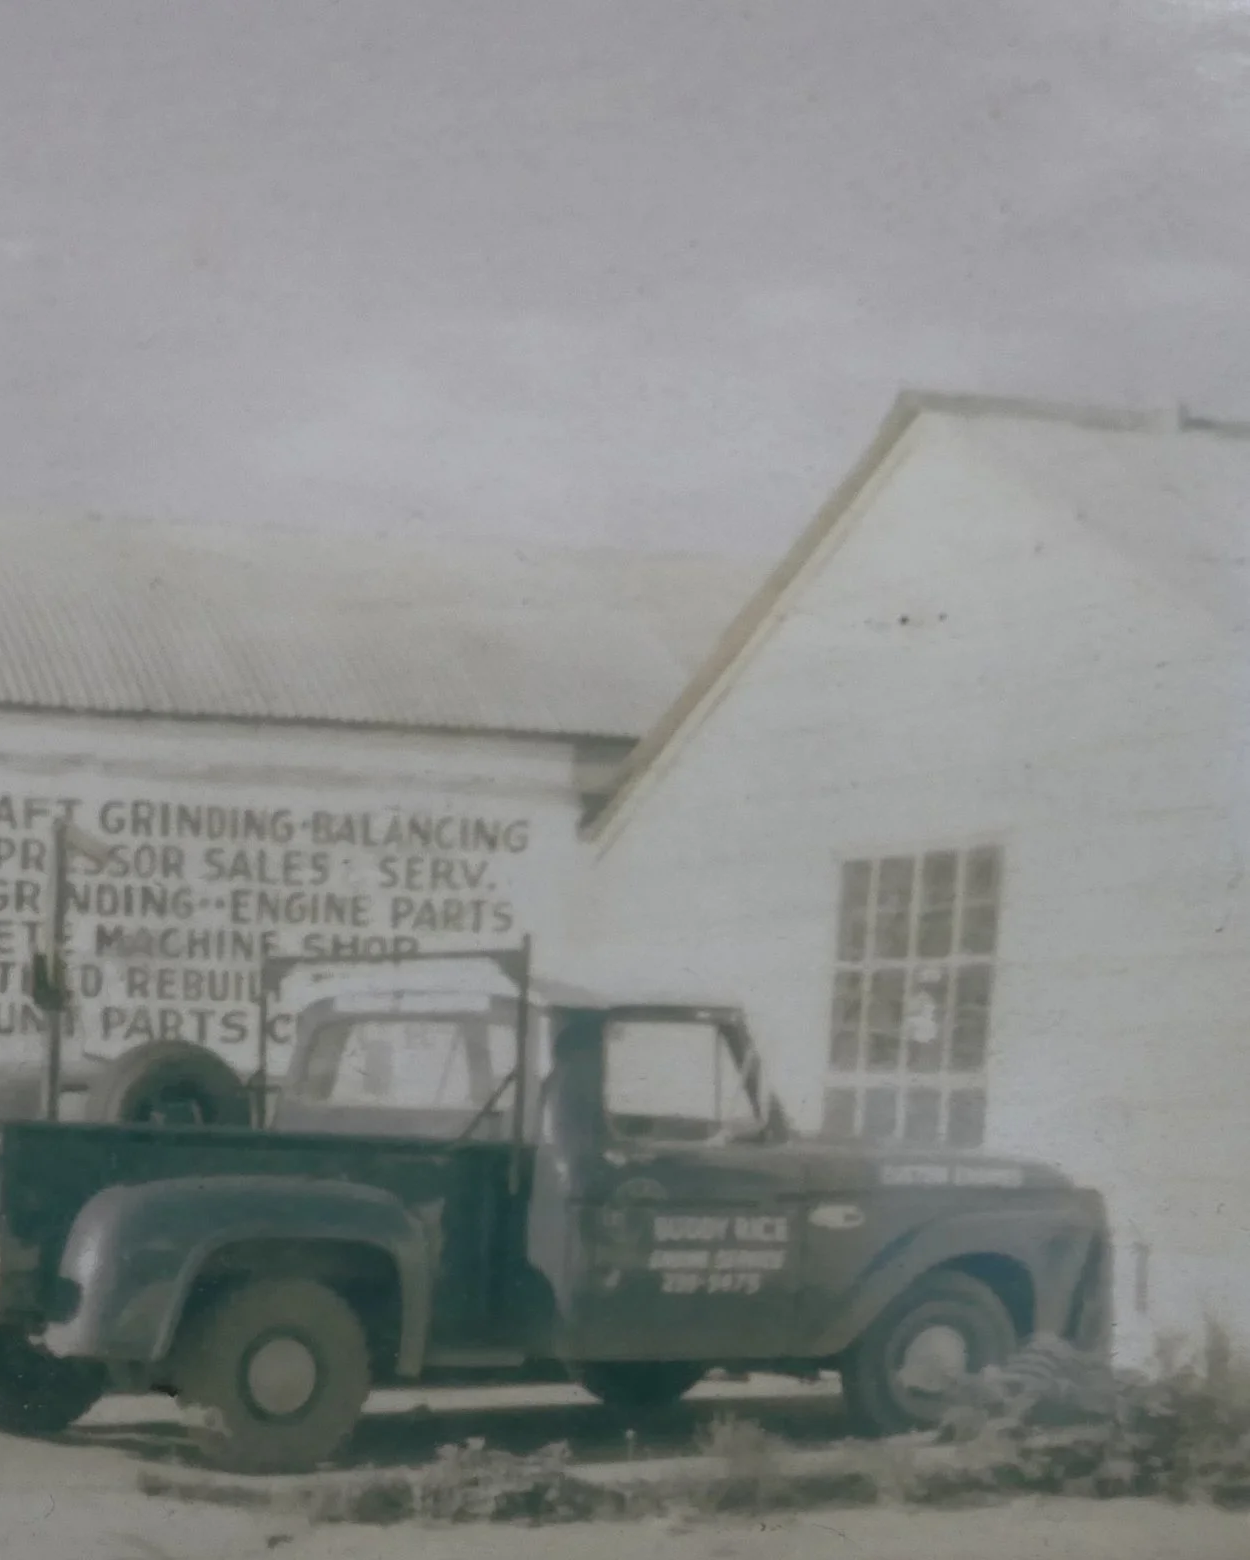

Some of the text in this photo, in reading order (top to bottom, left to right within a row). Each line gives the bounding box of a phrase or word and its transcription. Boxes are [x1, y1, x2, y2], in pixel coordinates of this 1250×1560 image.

[203, 847, 331, 887] SALES
[378, 854, 497, 892] SERV.
[390, 896, 514, 934] PARTS
[302, 932, 420, 961] SHOP
[102, 1004, 253, 1048] PARTS
